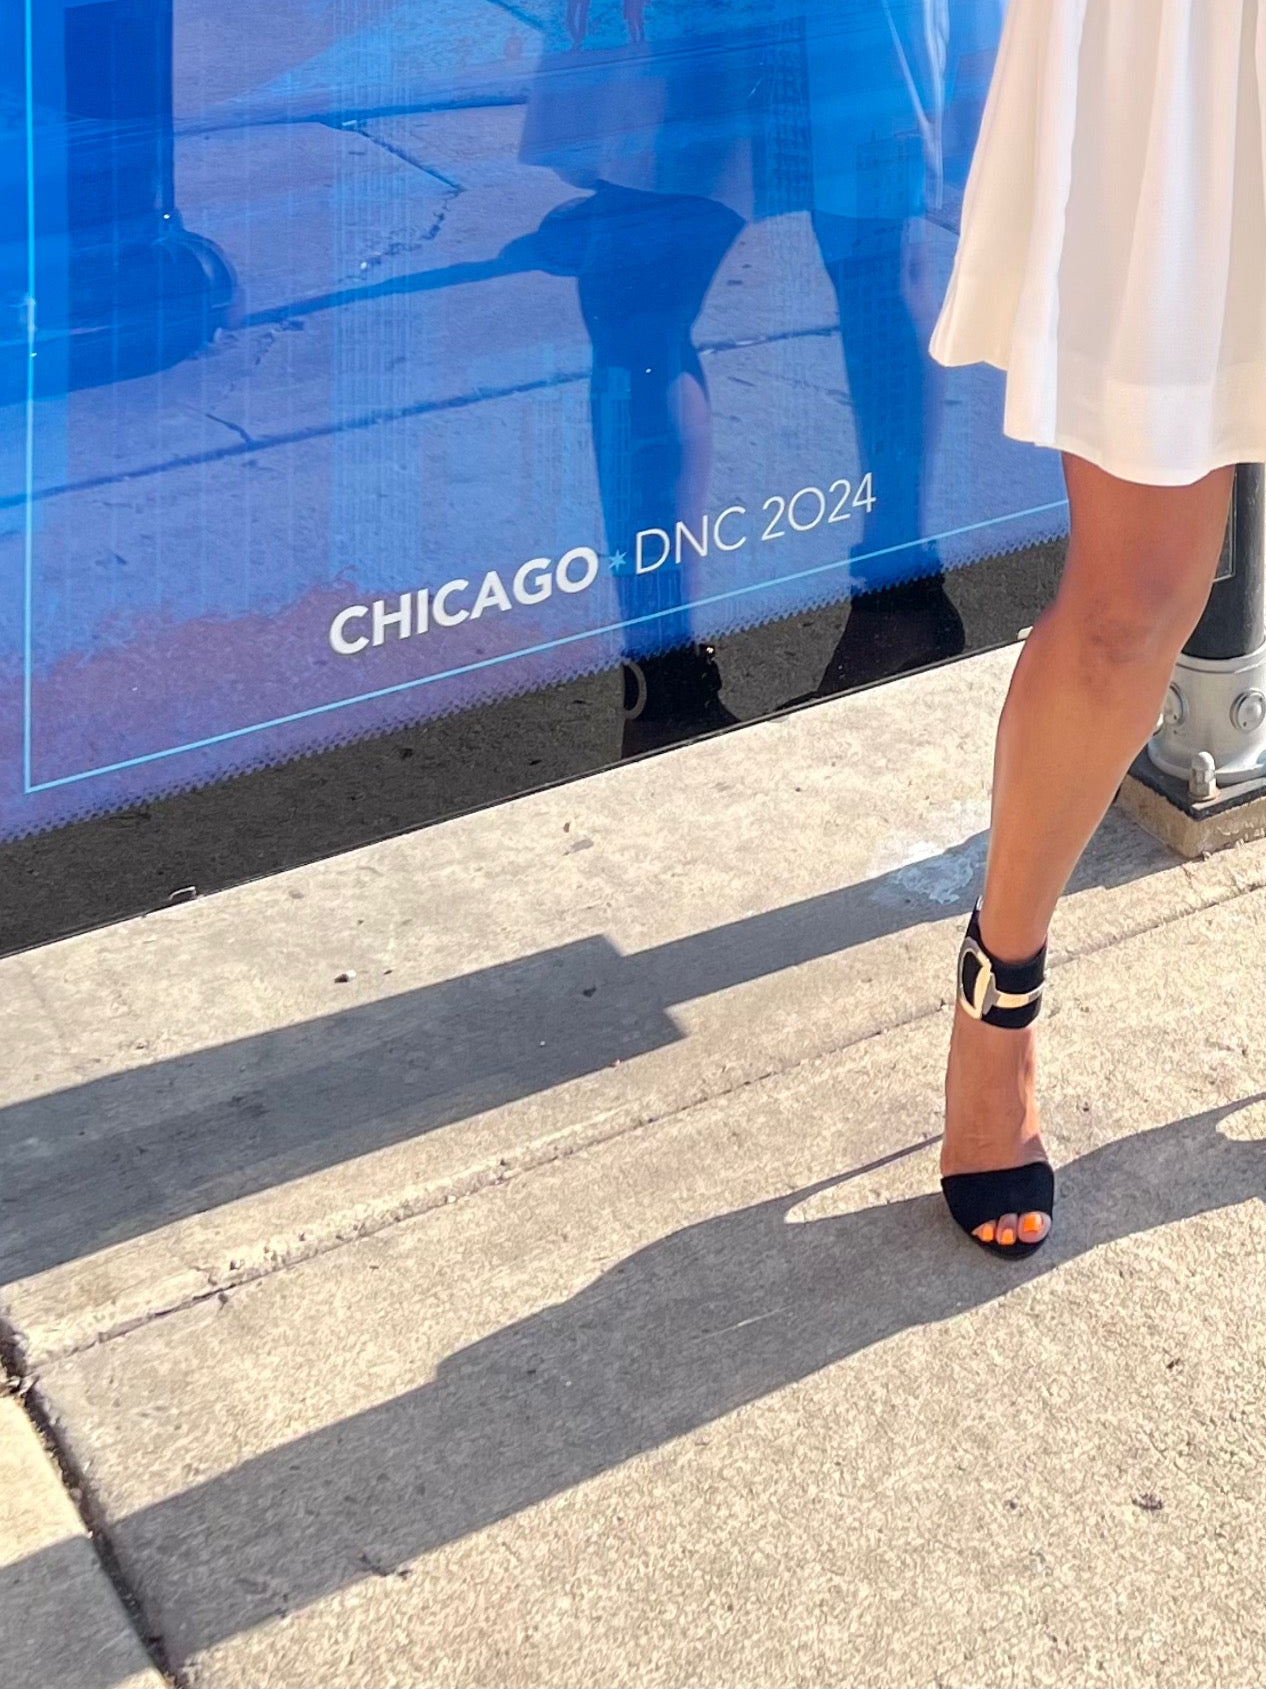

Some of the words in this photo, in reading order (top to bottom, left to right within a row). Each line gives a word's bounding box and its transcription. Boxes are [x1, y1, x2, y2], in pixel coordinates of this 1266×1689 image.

[329, 546, 598, 655] CHICAGO
[635, 507, 747, 574] DNC
[760, 472, 877, 543] 2024
